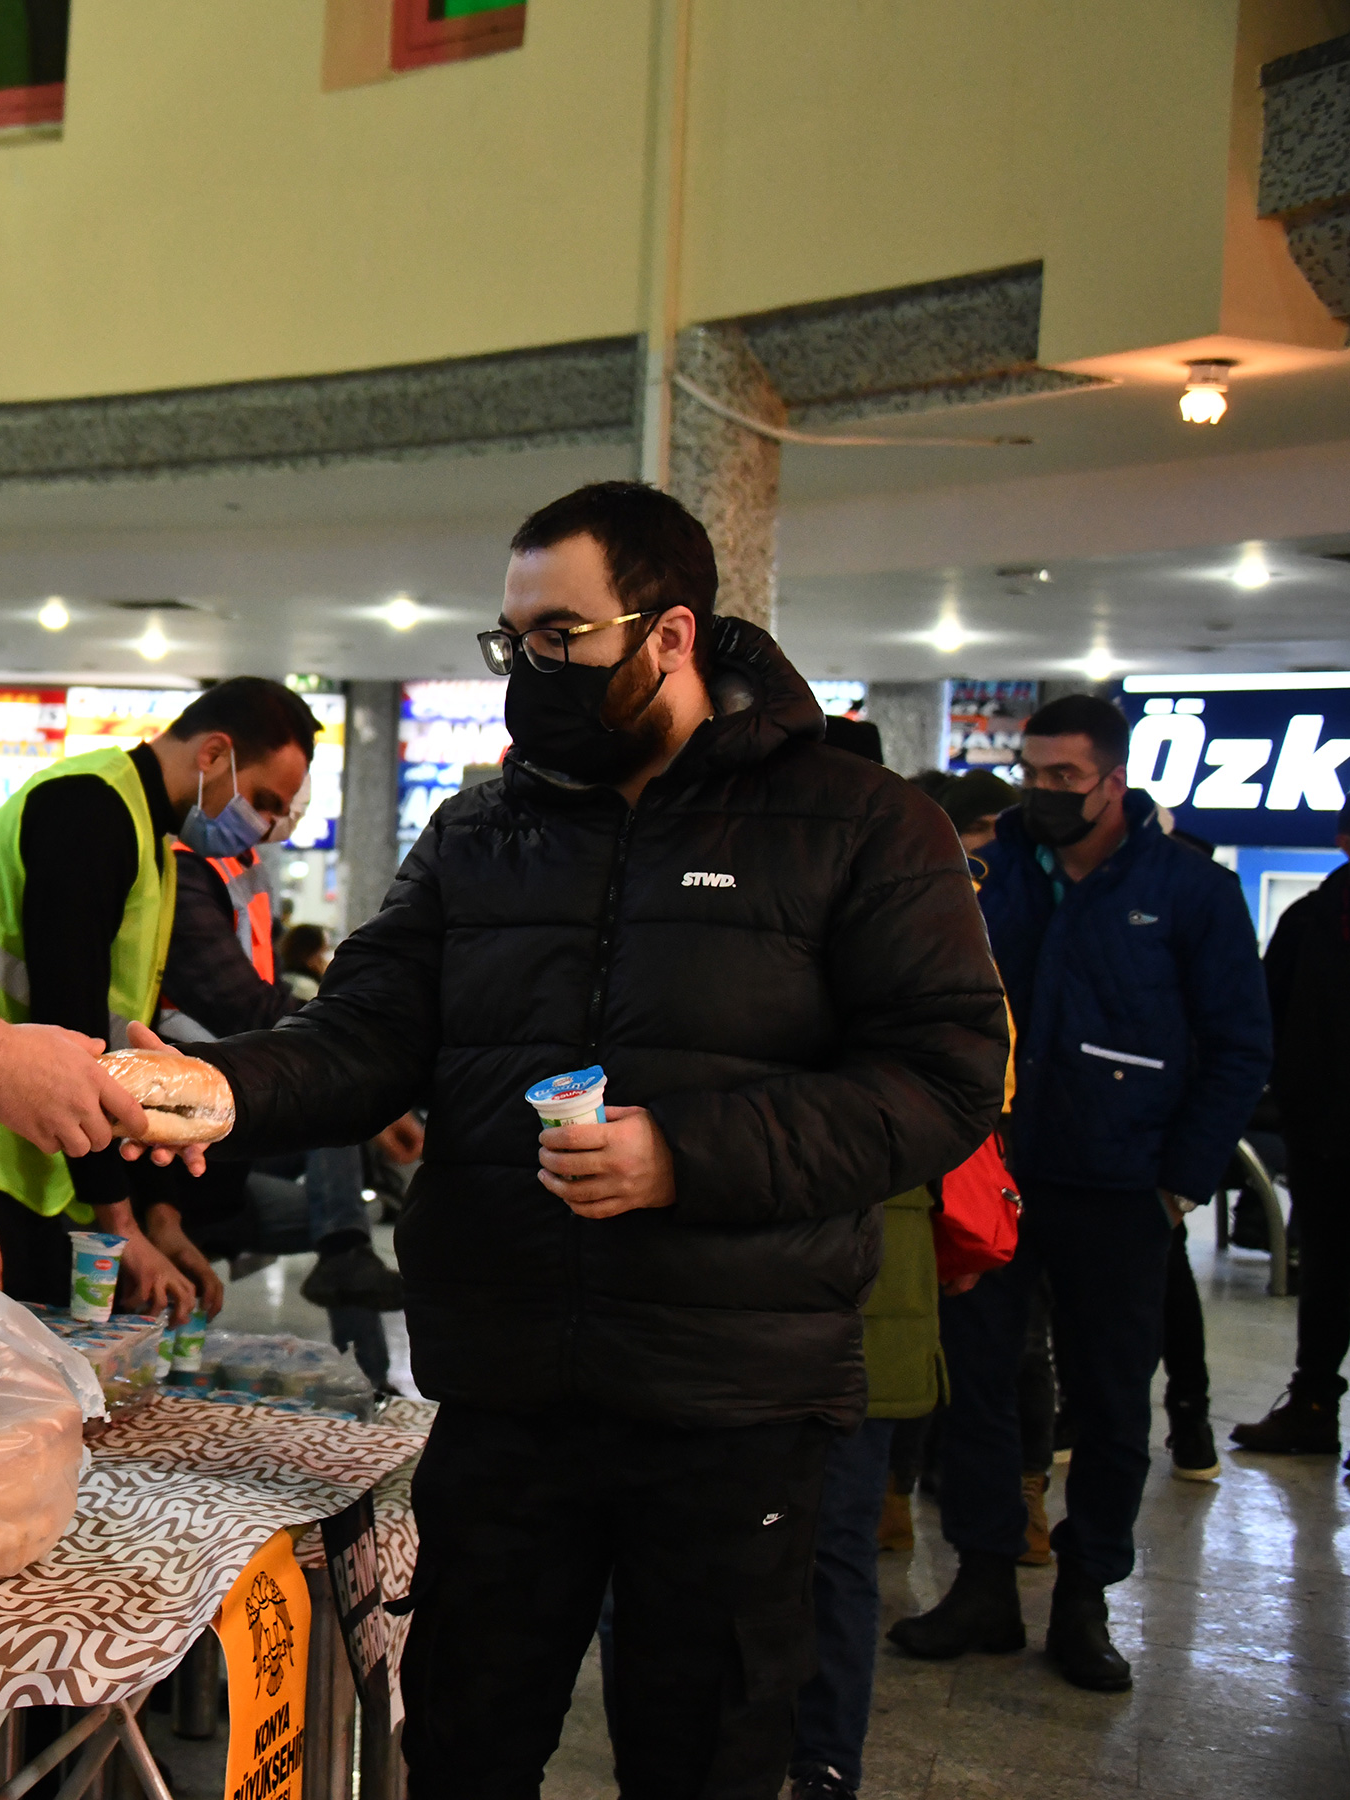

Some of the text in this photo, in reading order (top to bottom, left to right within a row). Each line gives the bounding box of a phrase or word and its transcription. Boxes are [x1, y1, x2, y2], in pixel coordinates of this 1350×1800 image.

[1125, 697, 1350, 812] Özk
[681, 871, 737, 888] STWD.
[254, 1702, 290, 1760] KONYA
